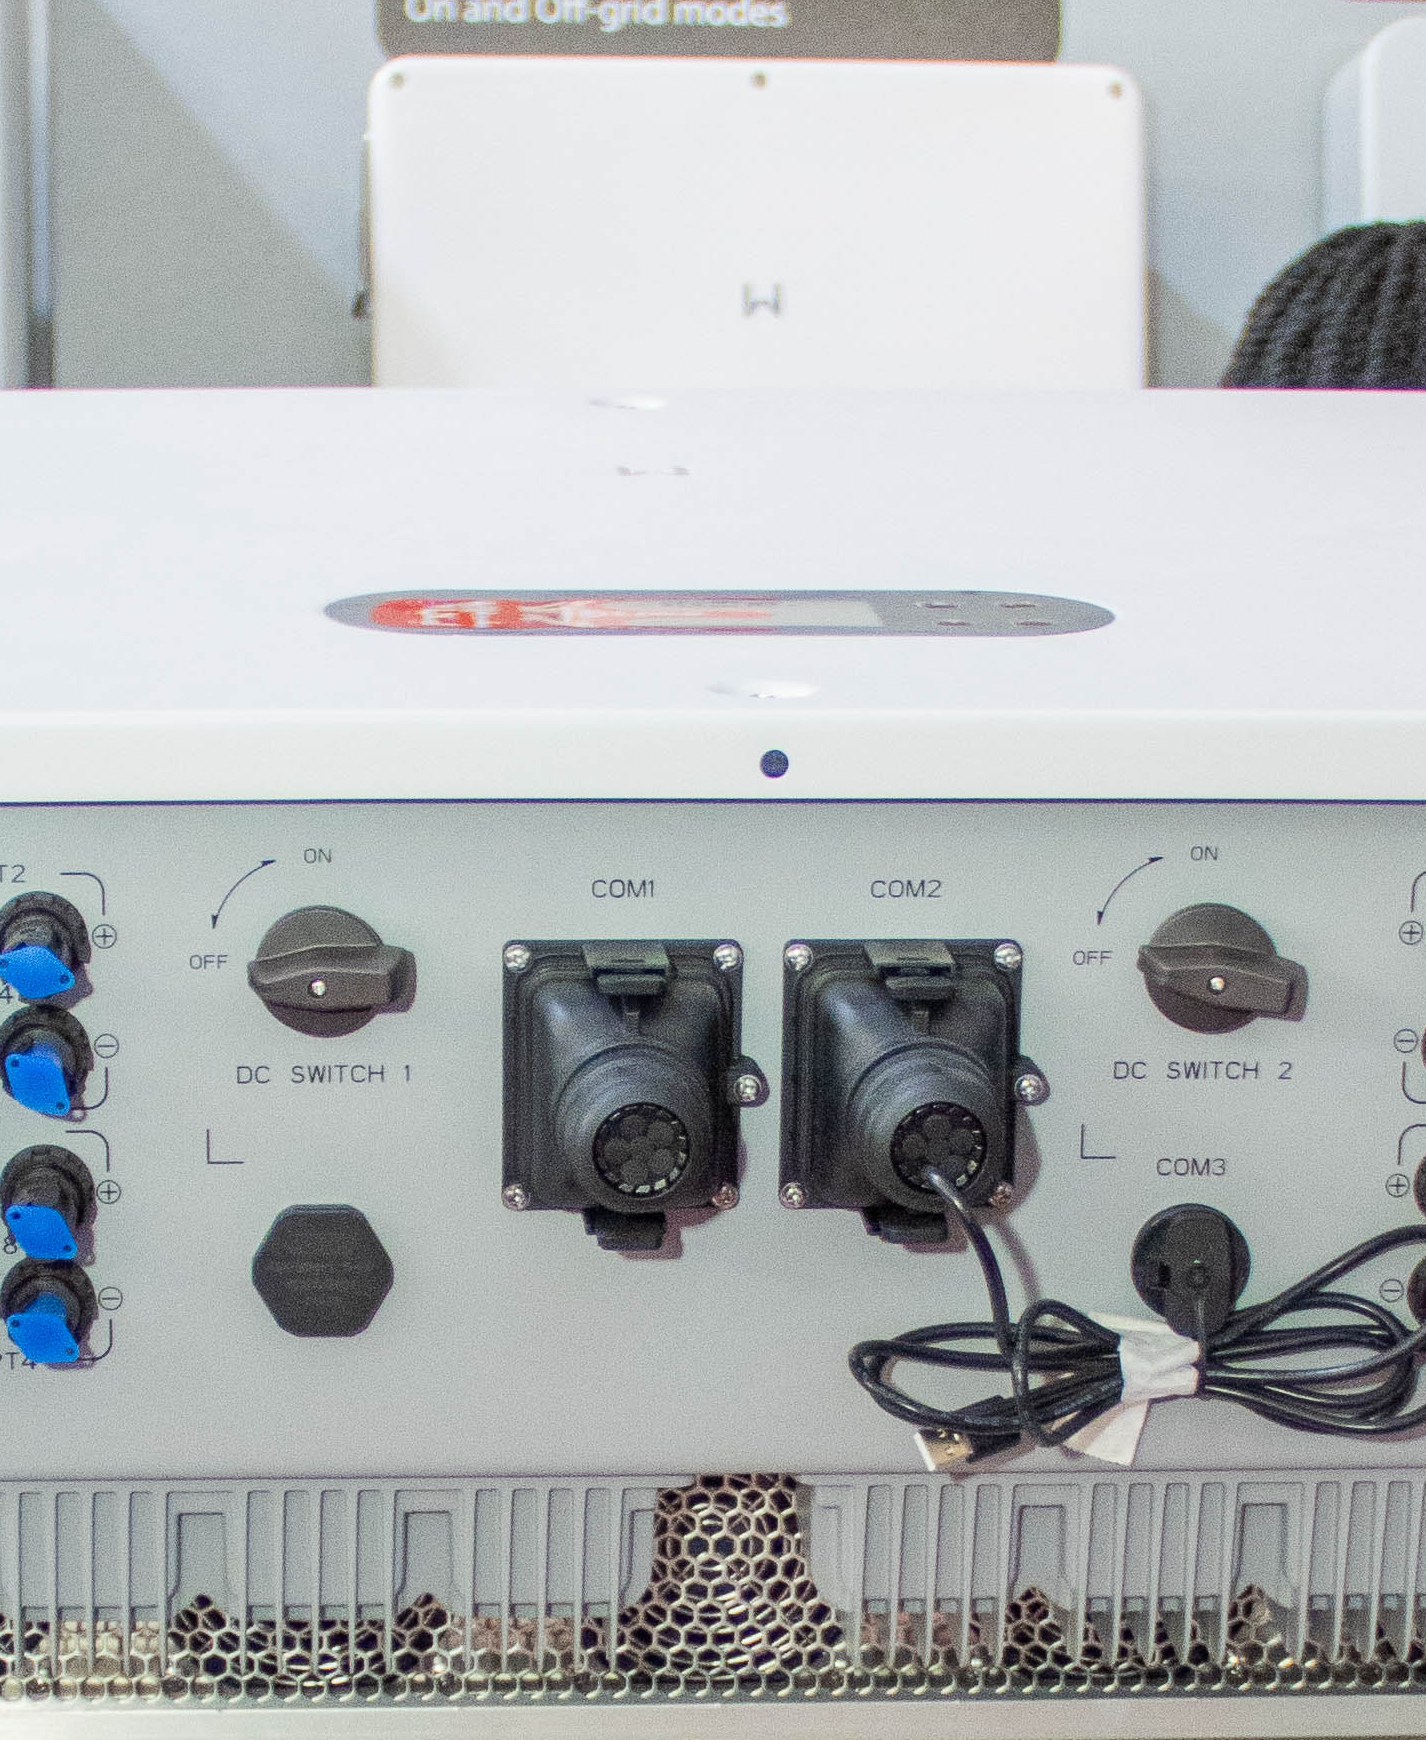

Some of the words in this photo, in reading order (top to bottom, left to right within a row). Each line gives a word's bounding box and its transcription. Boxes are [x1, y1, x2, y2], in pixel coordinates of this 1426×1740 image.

[303, 847, 333, 864] ON
[1190, 845, 1219, 861] ON
[591, 878, 655, 899] COM1
[870, 879, 943, 899] COM2
[189, 954, 228, 970] OFF
[1072, 950, 1113, 966] OFF
[236, 1065, 270, 1085] DC
[291, 1064, 385, 1084] SWITCH
[404, 1064, 411, 1082] 1
[1113, 1060, 1147, 1080] DC
[1167, 1061, 1260, 1080] SWITCH
[1278, 1061, 1293, 1081] 2
[1156, 1157, 1226, 1177] COM3
